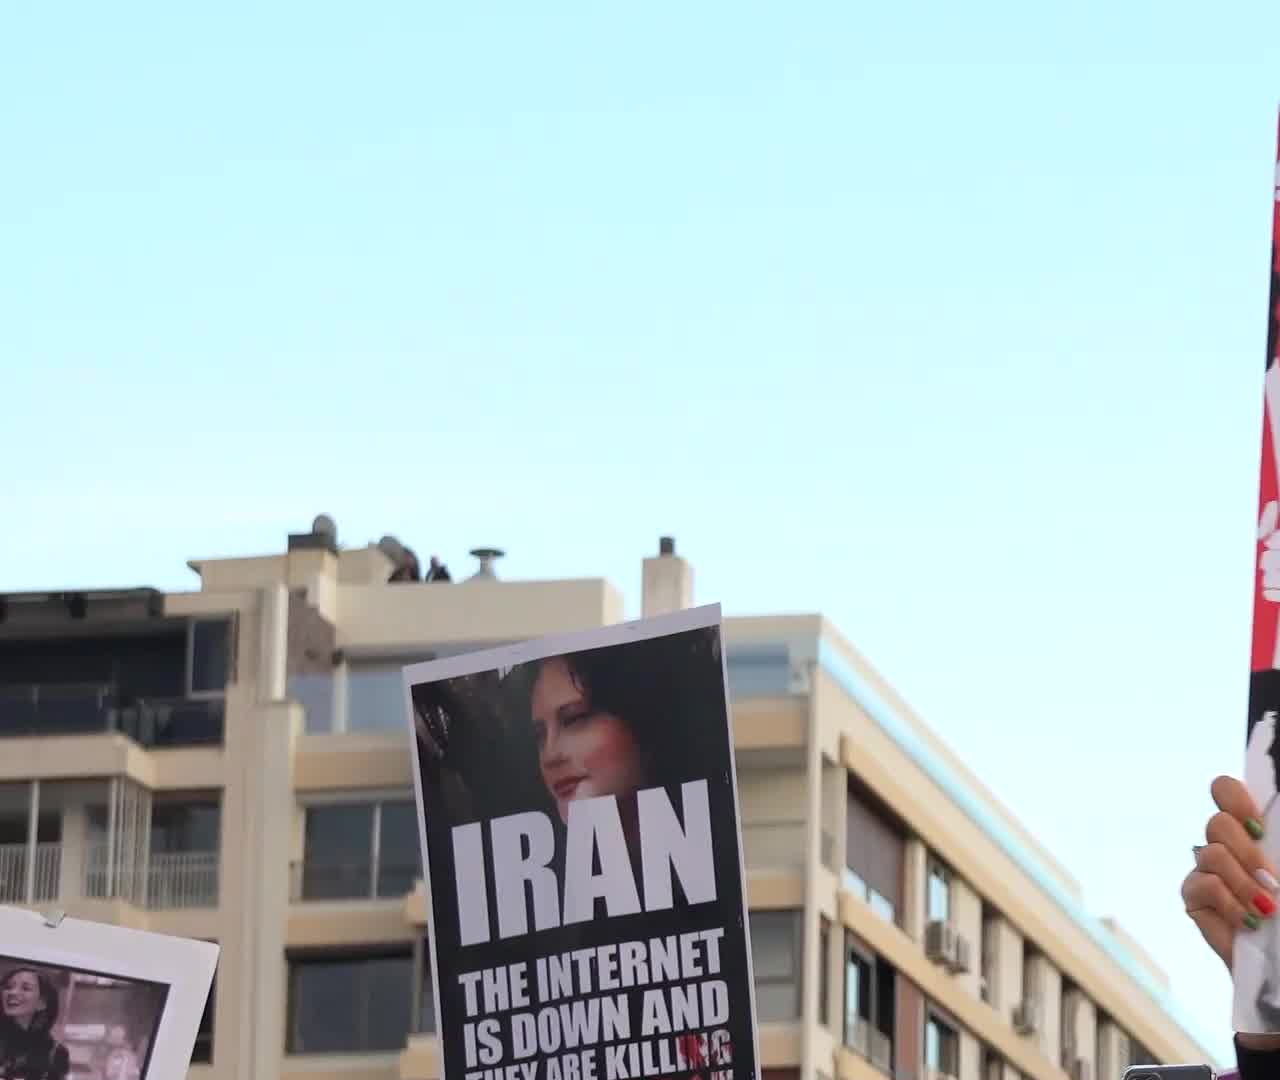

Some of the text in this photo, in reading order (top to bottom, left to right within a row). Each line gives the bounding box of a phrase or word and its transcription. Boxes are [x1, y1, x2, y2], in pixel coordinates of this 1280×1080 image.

[451, 779, 717, 947] IRAN
[458, 928, 724, 1017] THE INTERNET
[463, 980, 729, 1069] IS DOWN AND
[605, 1030, 731, 1080] KILLING
